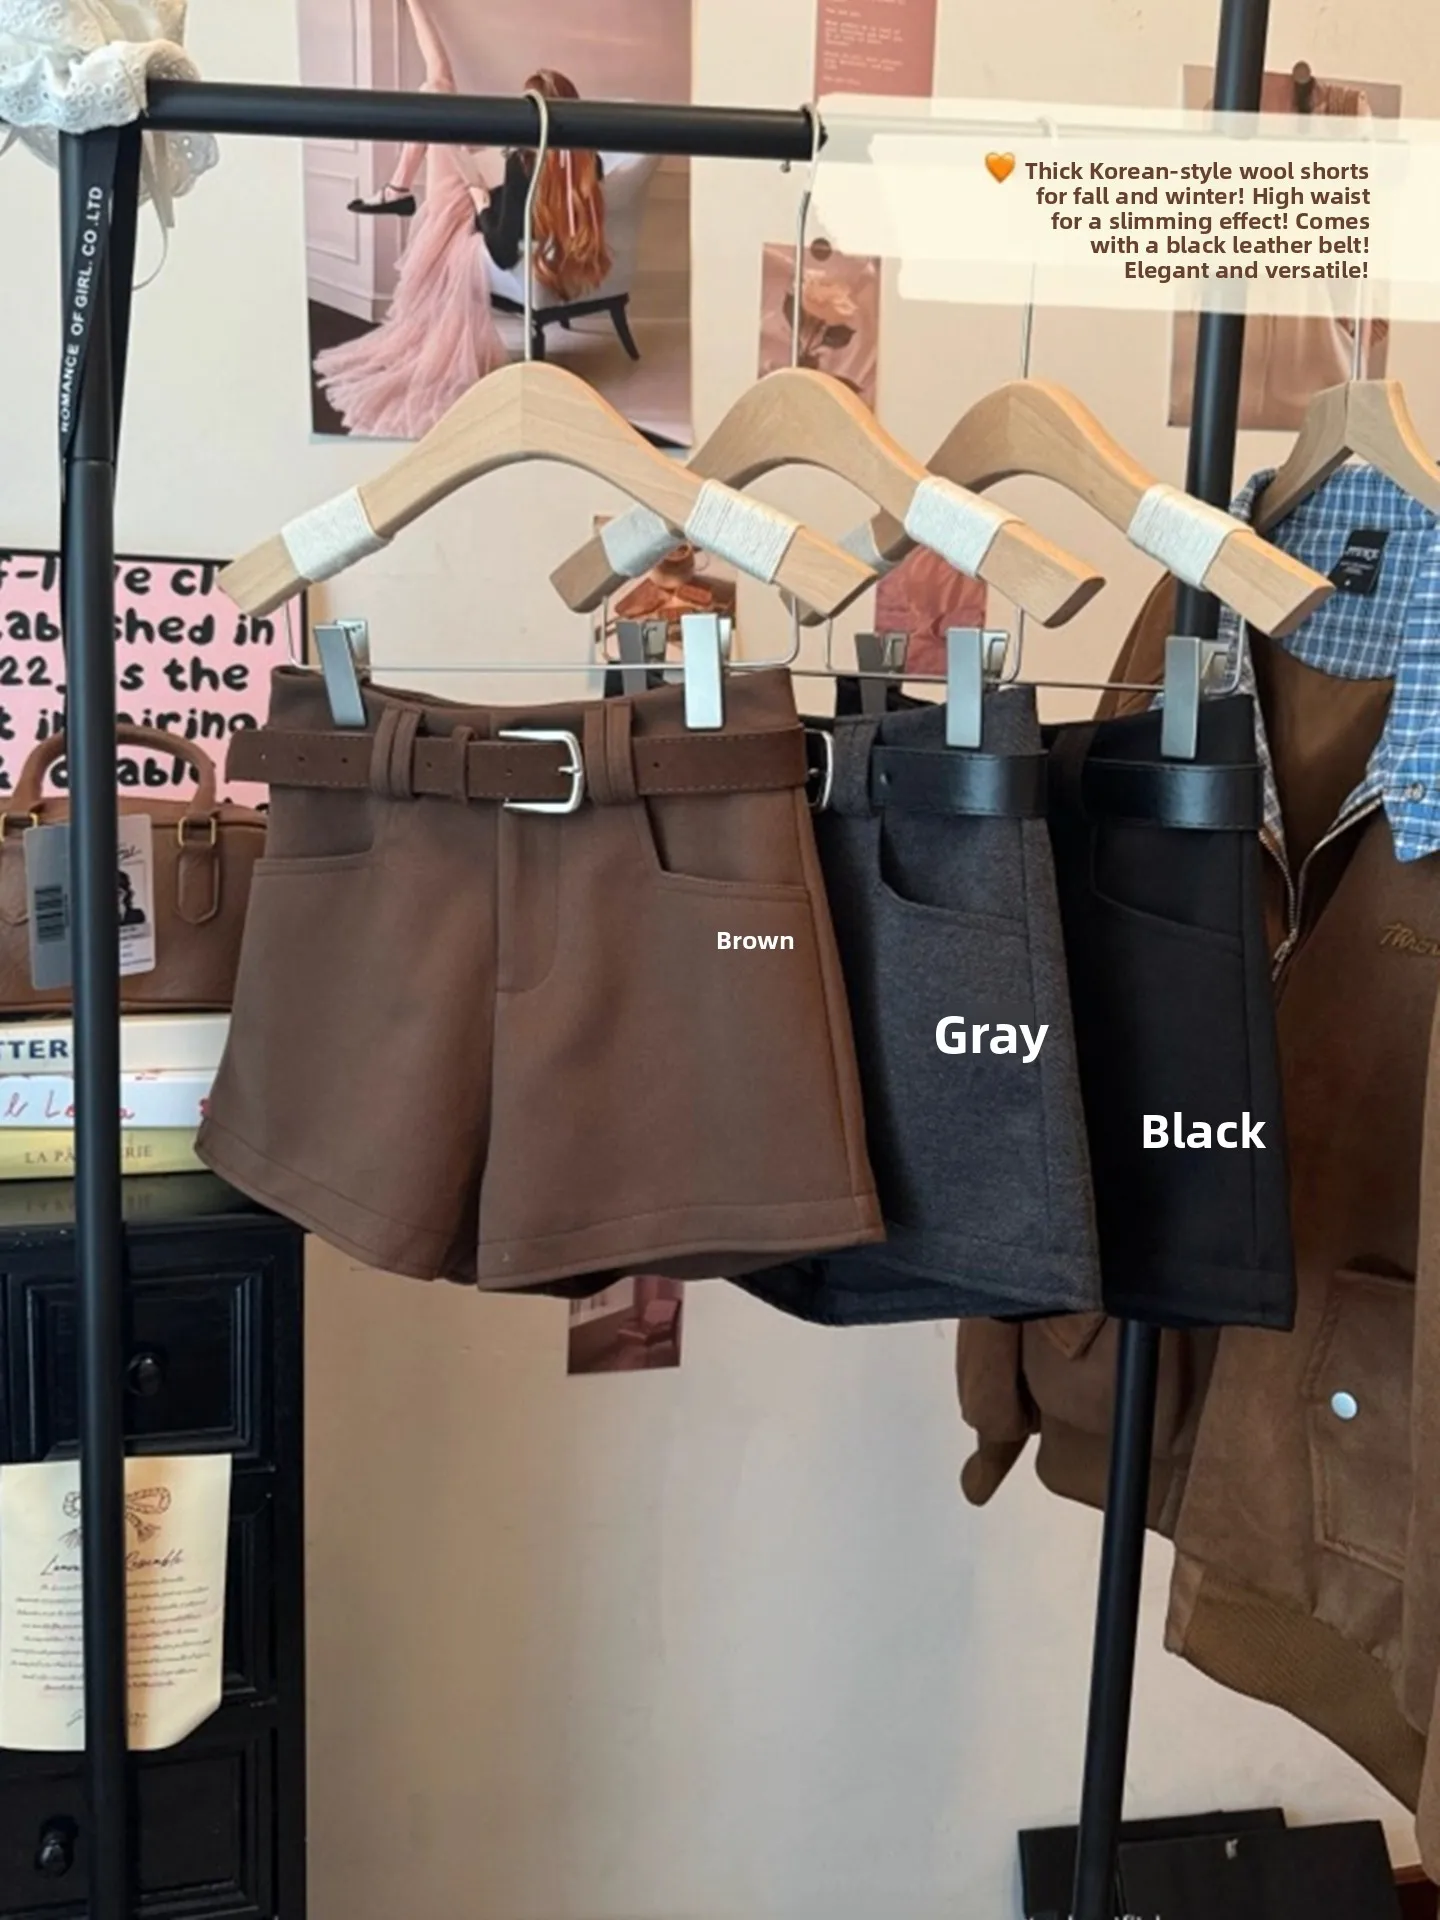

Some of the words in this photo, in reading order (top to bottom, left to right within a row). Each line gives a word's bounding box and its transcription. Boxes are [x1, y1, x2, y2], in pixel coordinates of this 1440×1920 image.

[61, 344, 79, 433] ROMANCE
[70, 311, 85, 336] OF
[231, 611, 274, 645] in
[162, 656, 249, 692] the
